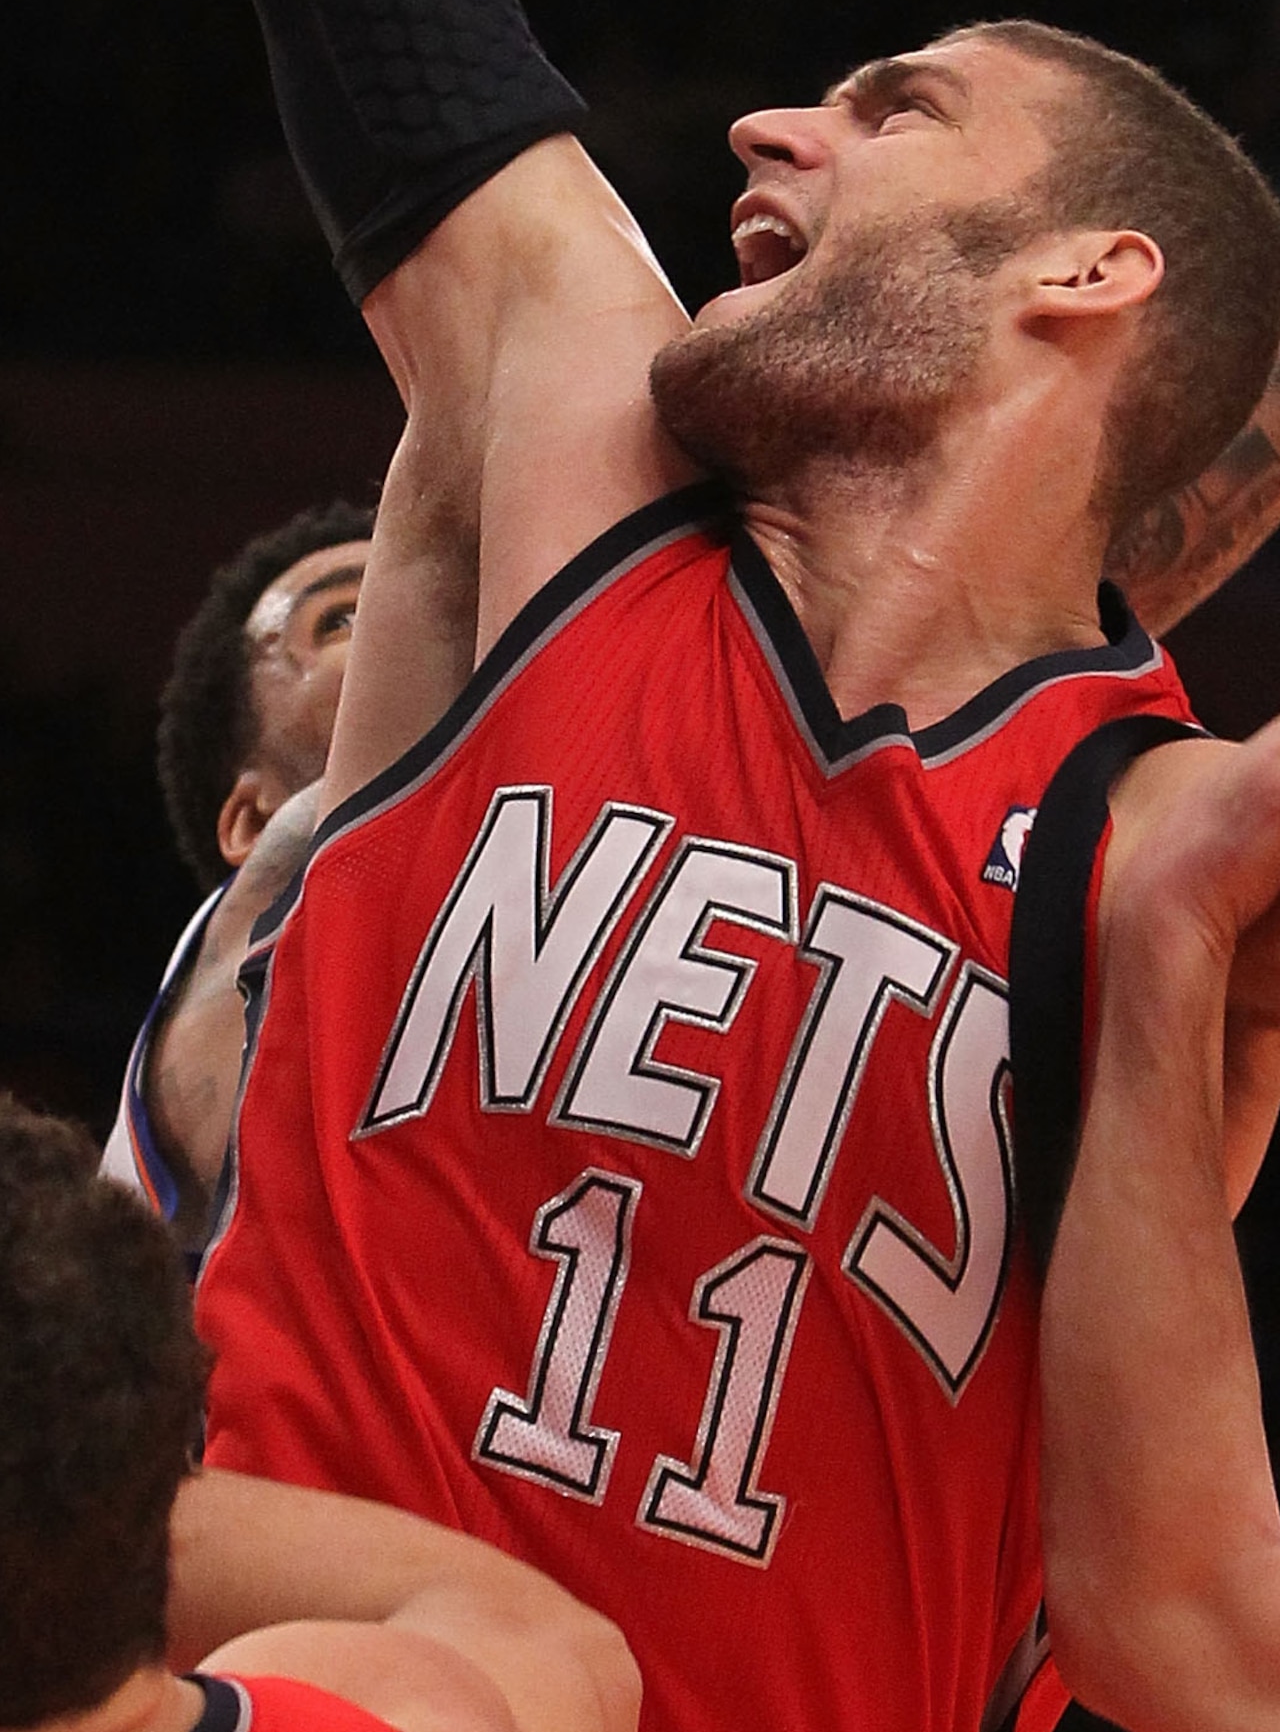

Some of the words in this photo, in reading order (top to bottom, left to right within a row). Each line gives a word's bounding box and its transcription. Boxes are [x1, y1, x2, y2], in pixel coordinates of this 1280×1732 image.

[982, 863, 1014, 887] NBA
[350, 784, 1015, 1405] NETS
[472, 1168, 811, 1569] 11
